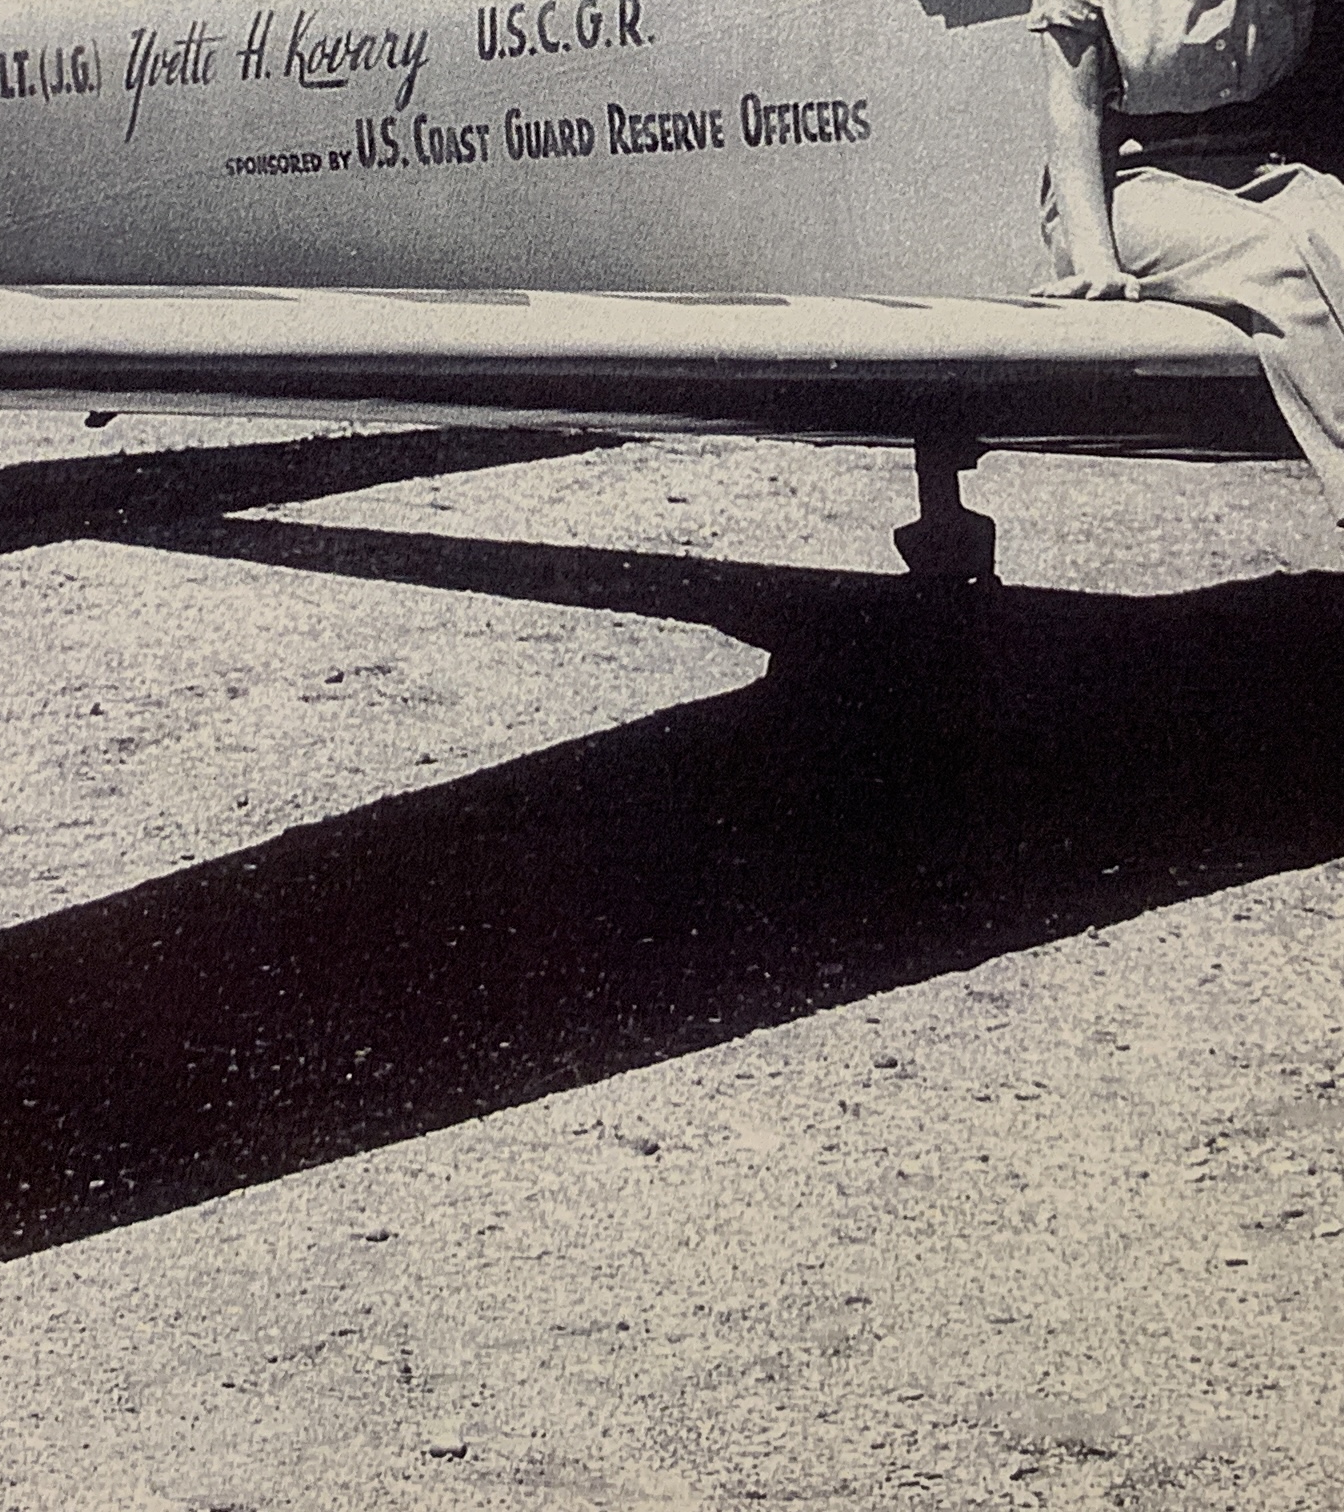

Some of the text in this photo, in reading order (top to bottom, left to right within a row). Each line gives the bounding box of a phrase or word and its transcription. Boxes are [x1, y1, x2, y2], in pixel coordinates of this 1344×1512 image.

[124, 19, 226, 144] Yvette
[236, 9, 272, 81] H.
[283, 8, 433, 112] Kovary
[224, 91, 873, 177] SPONSORED BY U.S. COAST GUARD RESERVE OFFICERS
